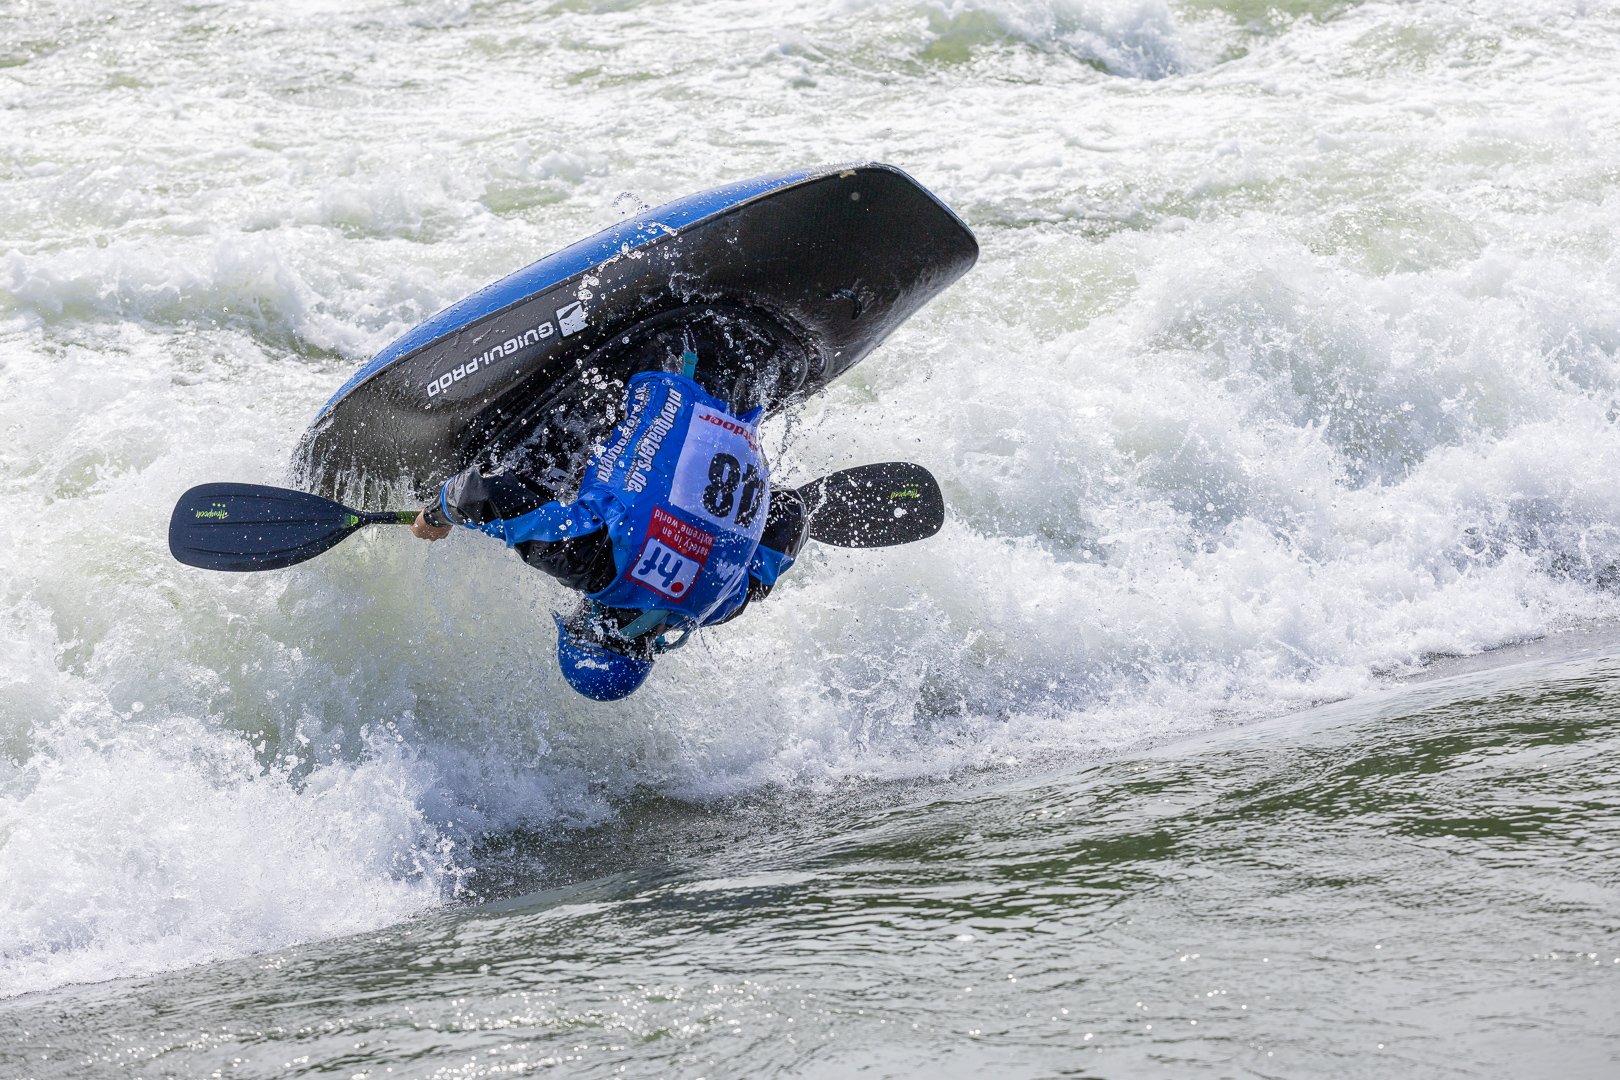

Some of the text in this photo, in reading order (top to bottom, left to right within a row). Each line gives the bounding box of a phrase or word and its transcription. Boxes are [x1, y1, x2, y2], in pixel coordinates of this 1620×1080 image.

[628, 388, 682, 493] playboaters.de
[703, 453, 765, 527] 48
[654, 509, 712, 544] extreme world
[662, 526, 709, 556] safety in an
